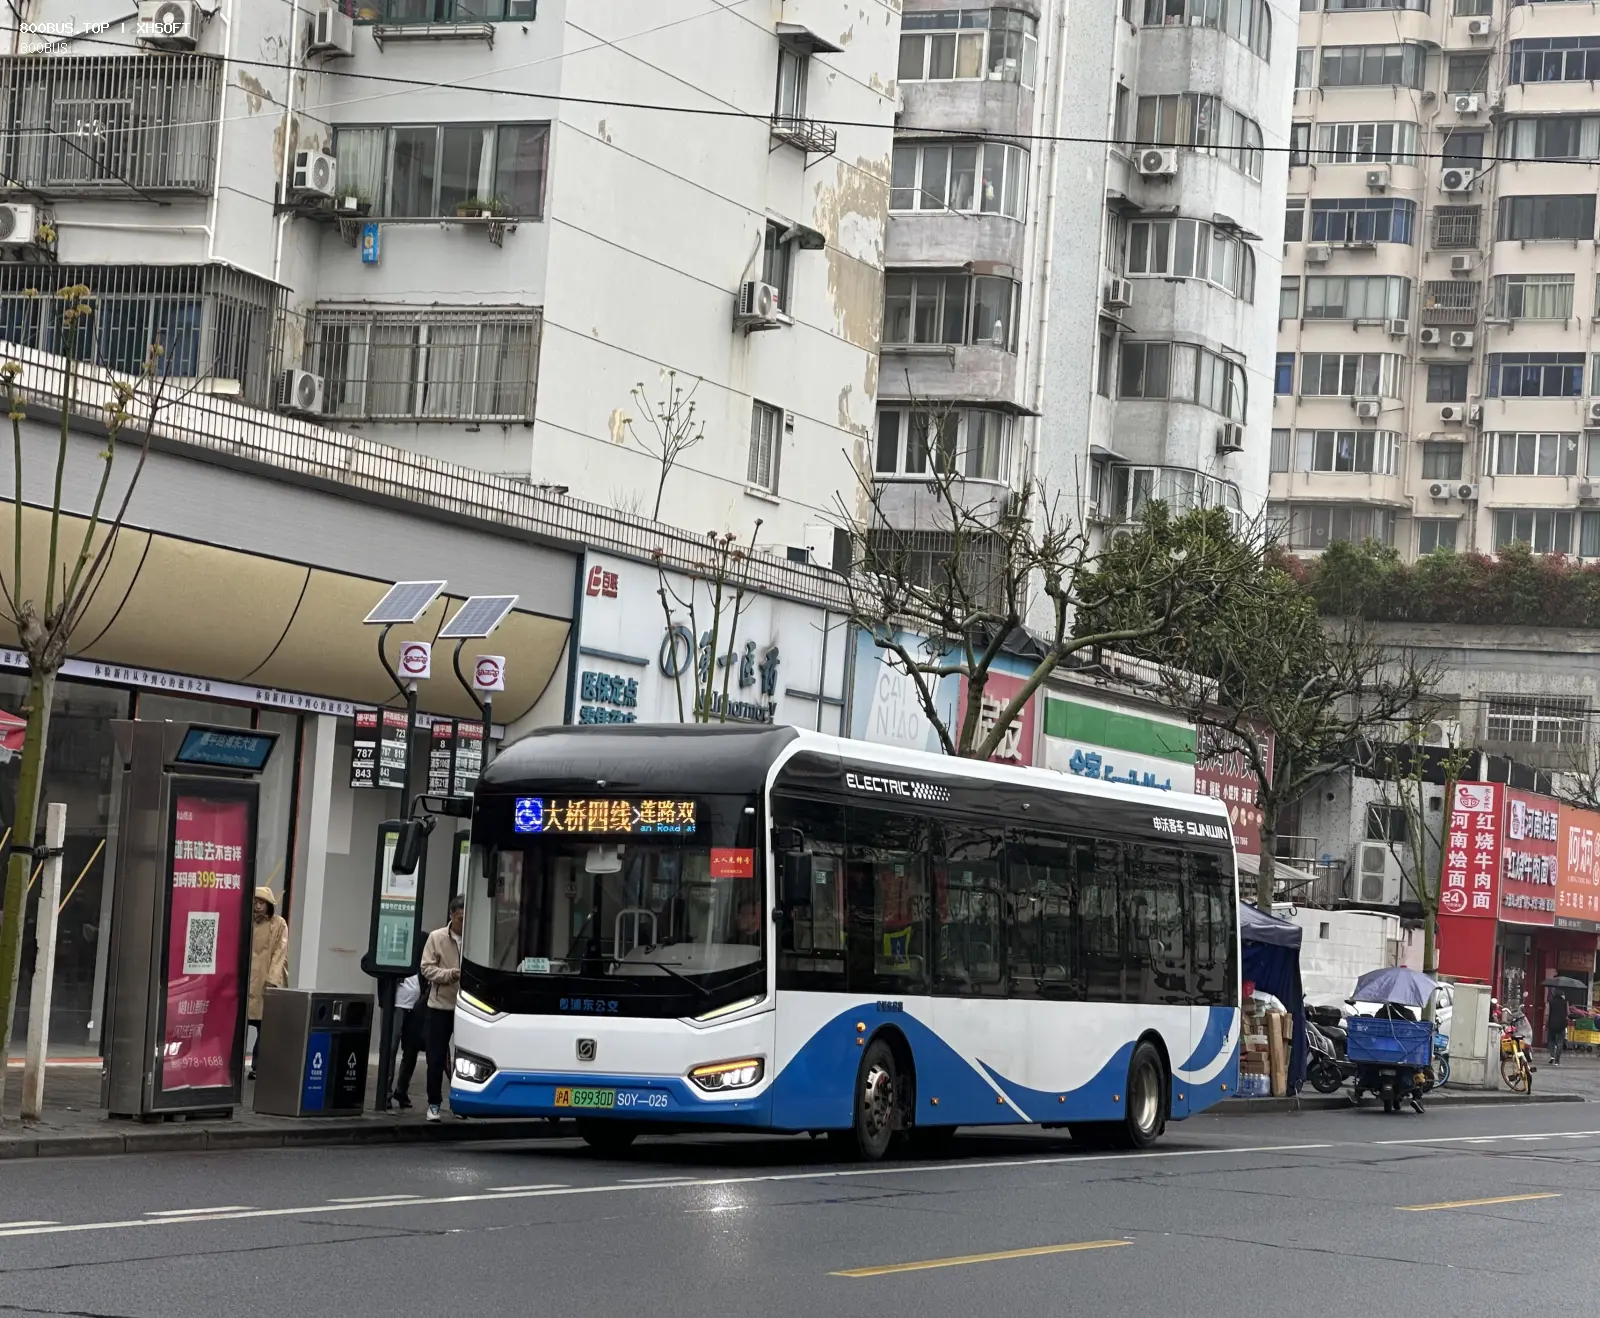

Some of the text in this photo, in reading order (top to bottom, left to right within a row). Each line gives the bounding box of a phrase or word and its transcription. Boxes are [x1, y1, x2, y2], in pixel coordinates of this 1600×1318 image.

[581, 671, 639, 707] 医保定点
[396, 728, 406, 738] 723
[440, 739, 446, 749] 8
[357, 748, 373, 758] 787
[355, 768, 371, 778] 843
[846, 773, 910, 796] ELECTRIC
[543, 799, 632, 832] 大桥四线
[657, 823, 681, 832] Road
[1153, 816, 1228, 840] 申沃客车 SUNWIN
[1448, 811, 1470, 888] 河南烩面
[1471, 813, 1495, 909] 红烧牛肉面
[1442, 891, 1460, 903] 24
[571, 999, 619, 1012] 浦东公交
